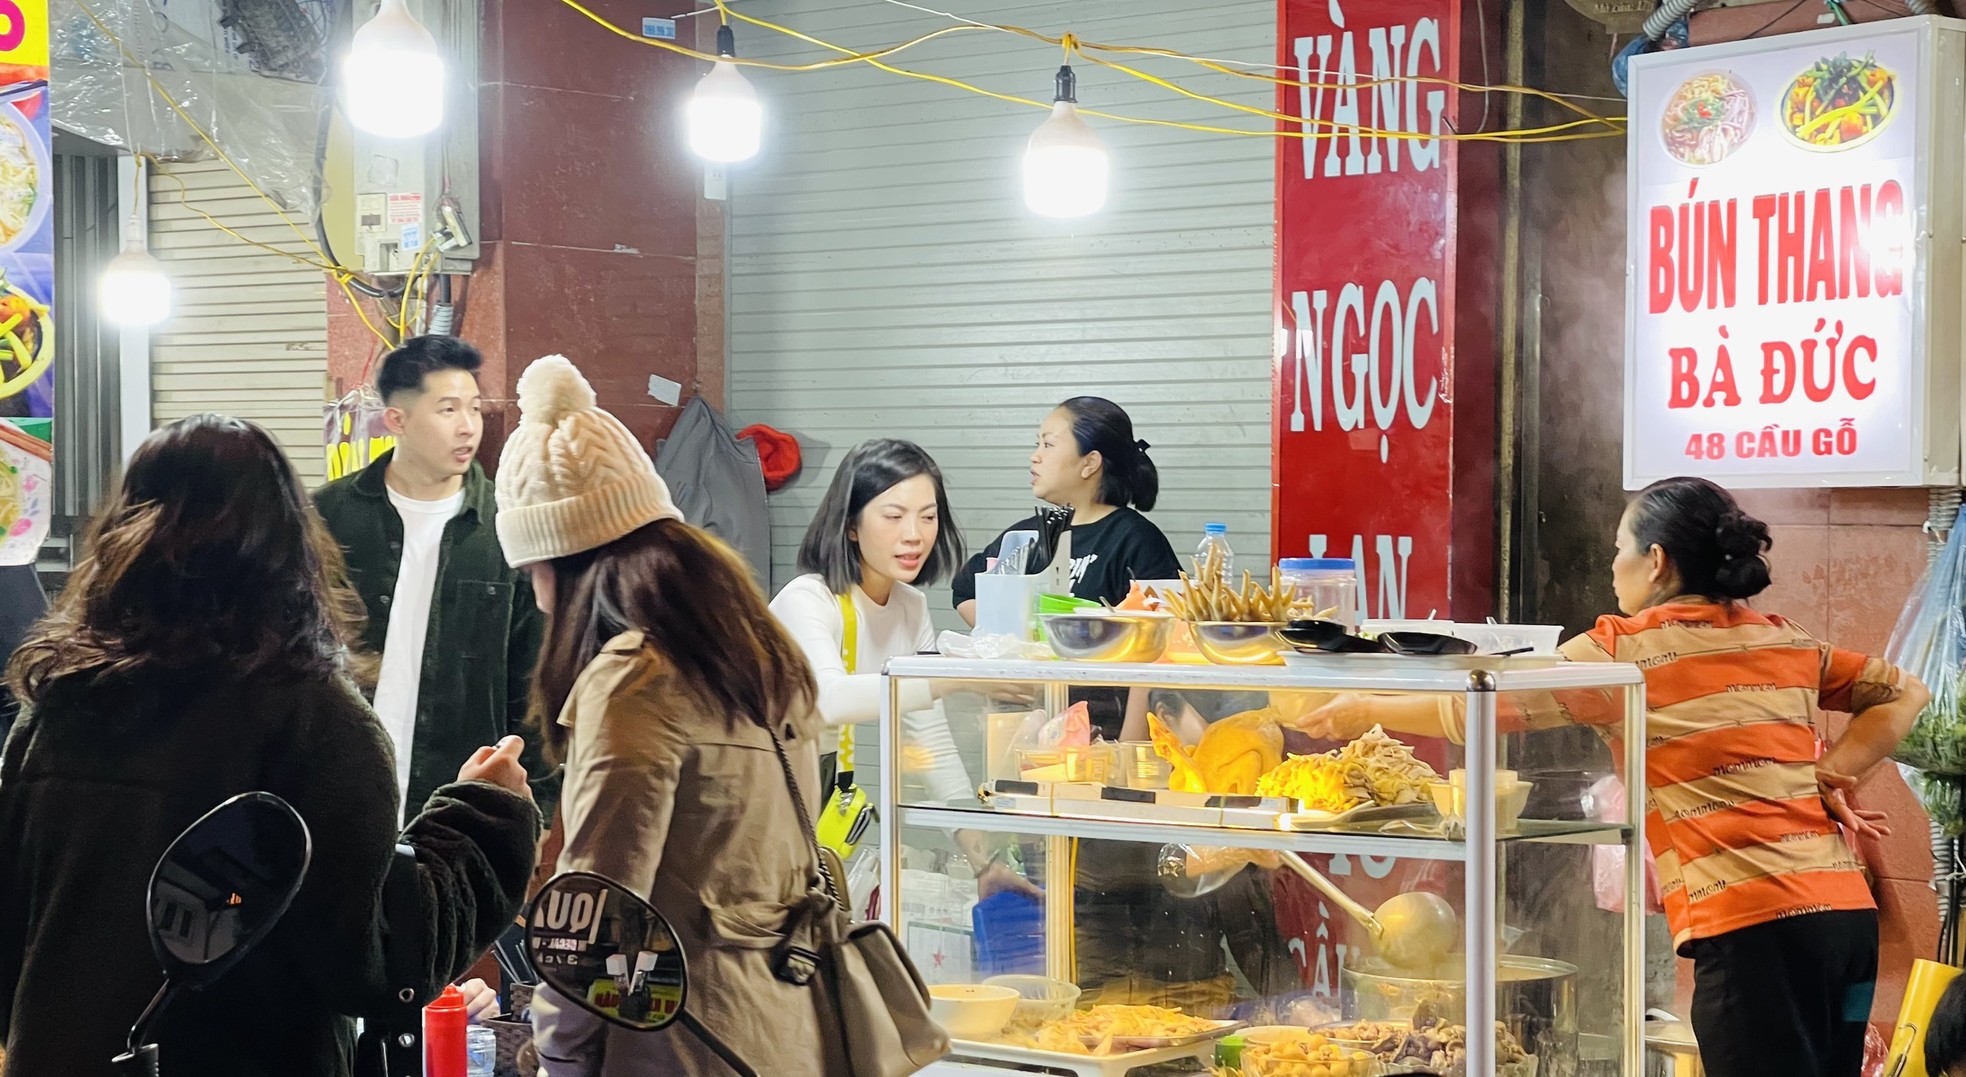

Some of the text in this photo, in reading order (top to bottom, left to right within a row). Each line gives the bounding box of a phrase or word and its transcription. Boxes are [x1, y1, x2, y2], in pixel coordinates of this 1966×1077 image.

[1294, 0, 1445, 179] VÀNG
[1649, 177, 1904, 314] BÚN THANG
[1291, 276, 1439, 464] NGỌC
[1667, 317, 1878, 409] BÀ ĐỨC
[1684, 418, 1857, 460] 48 CẦU GỖ
[1309, 534, 1413, 627] AN
